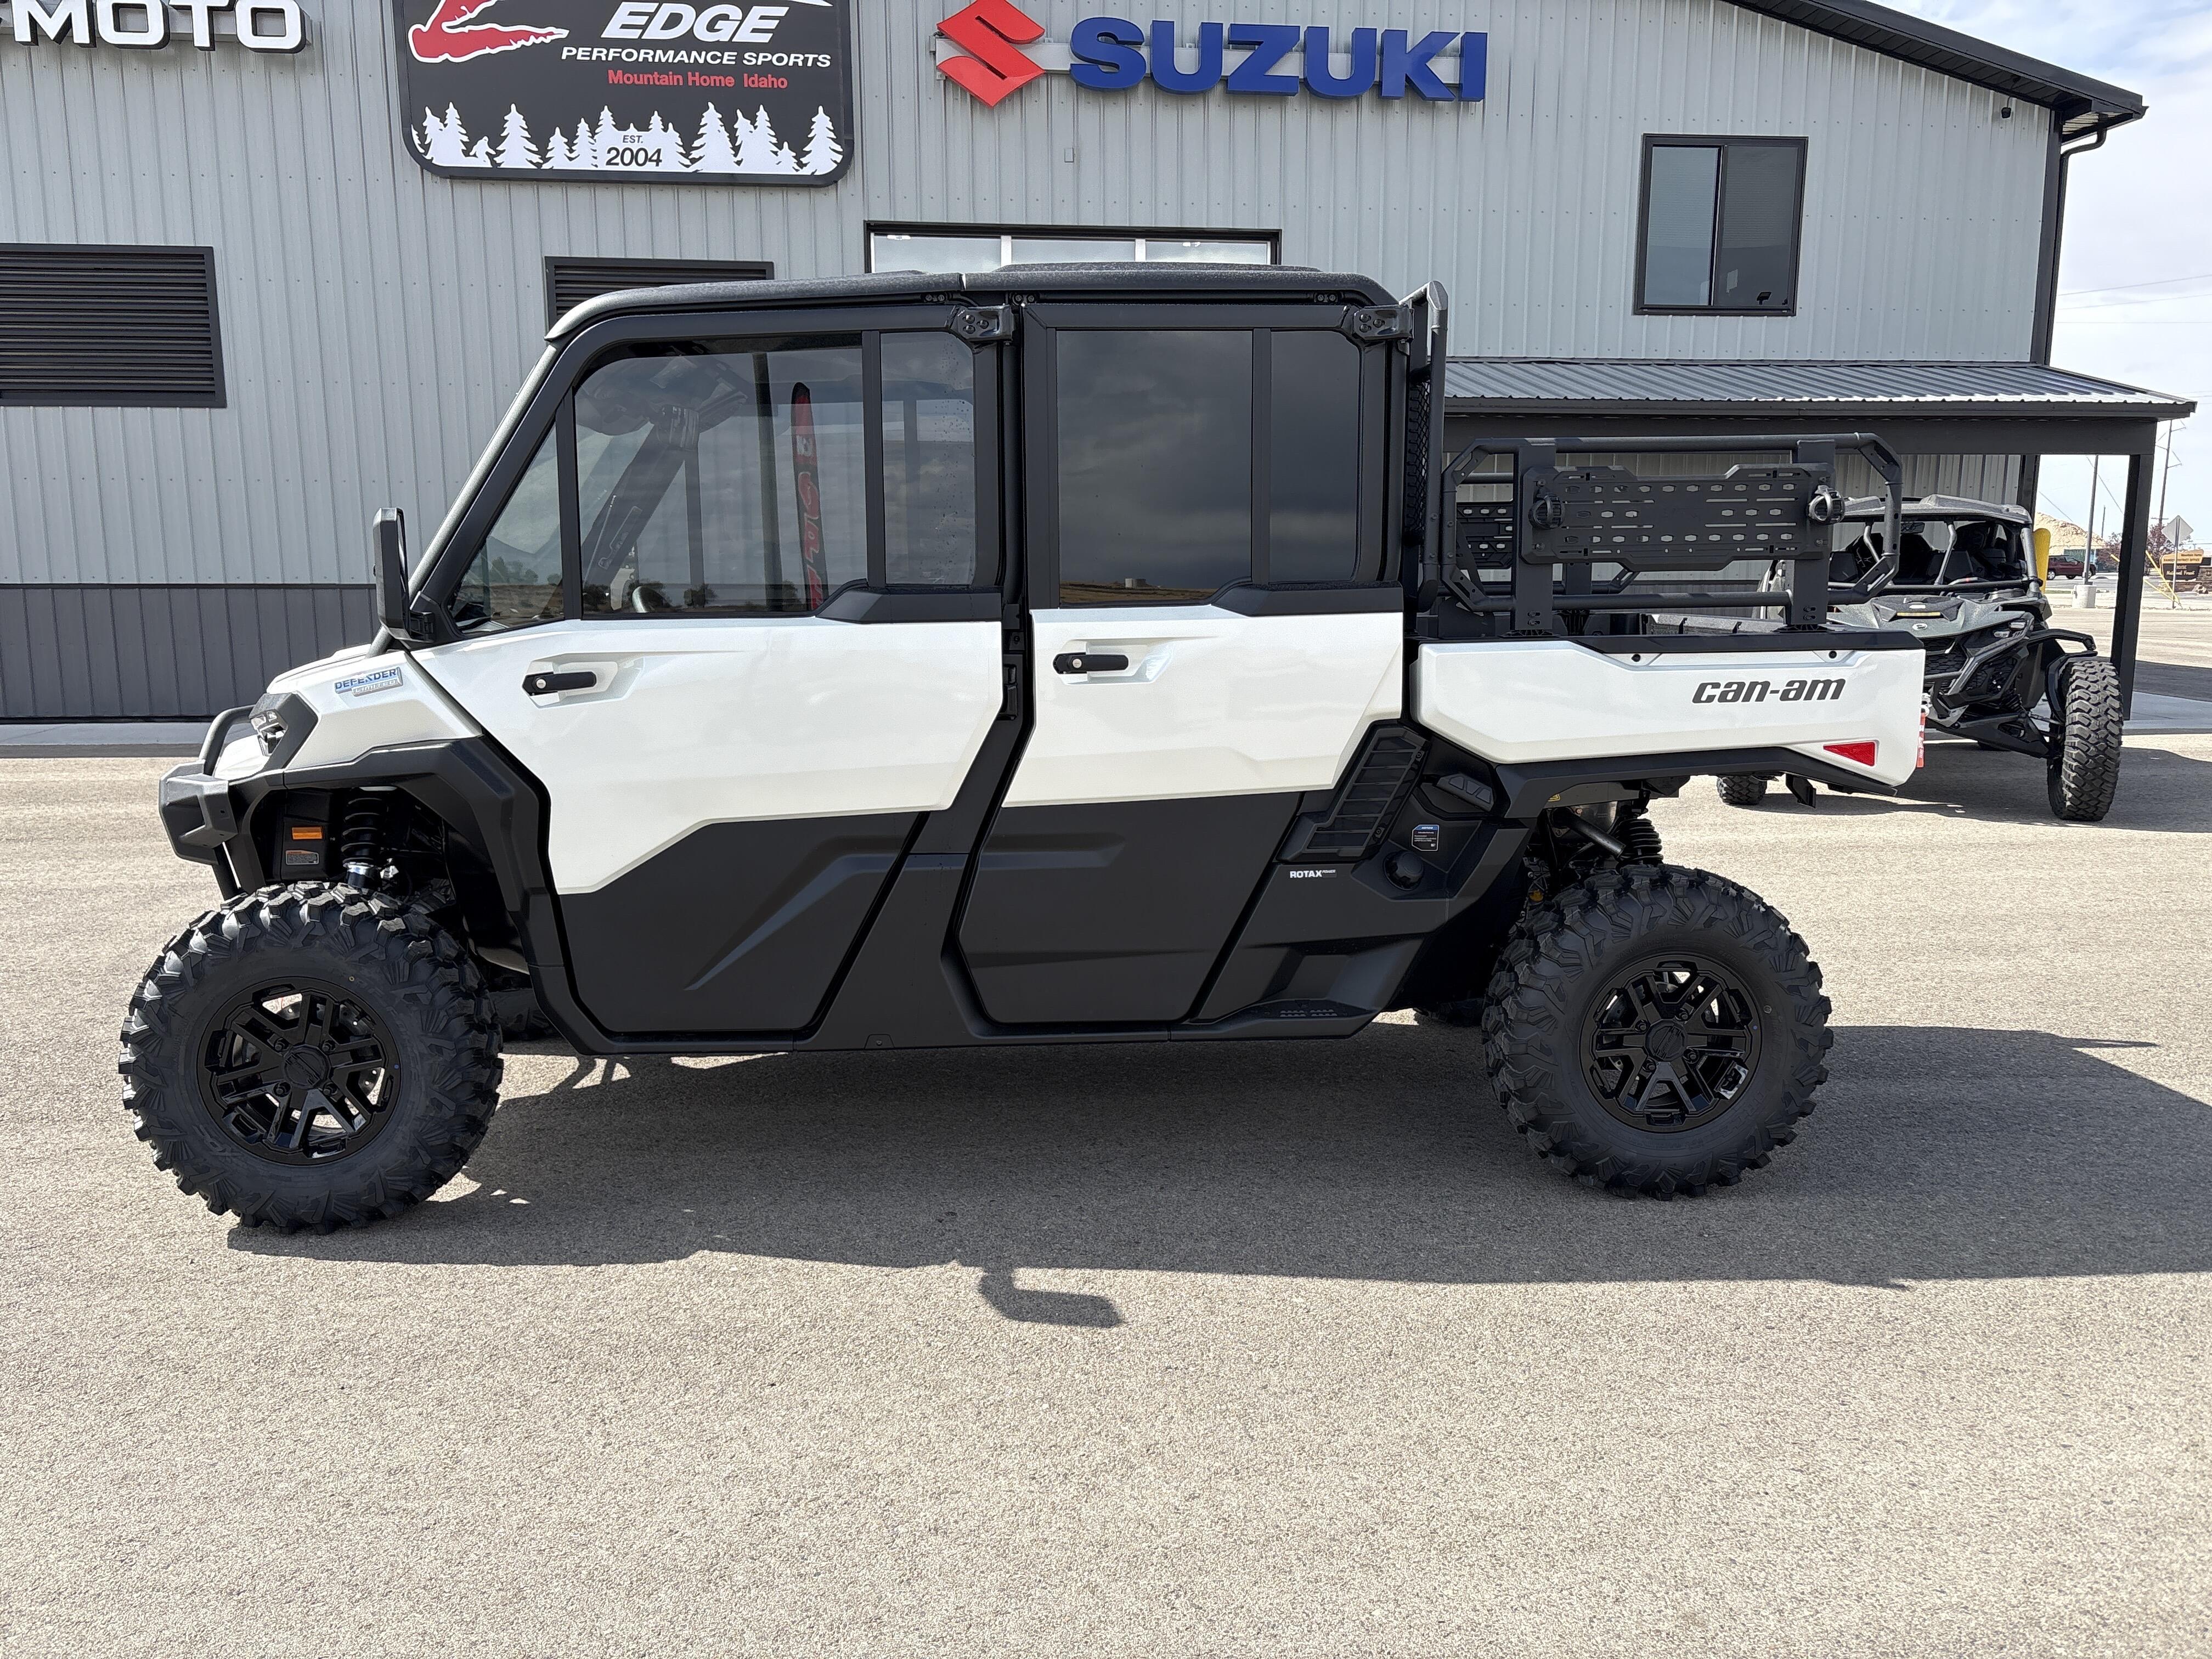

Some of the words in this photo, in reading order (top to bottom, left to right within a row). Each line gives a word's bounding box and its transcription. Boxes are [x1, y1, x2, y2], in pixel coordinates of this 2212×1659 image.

[600, 1, 790, 43] EDGE
[561, 46, 737, 65] PERFORMANCE
[742, 52, 832, 67] SPORTS
[1070, 16, 1487, 102] SUZUKI
[607, 70, 684, 86] Mountain
[687, 72, 735, 88] Home
[743, 74, 788, 89] Idaho
[622, 134, 644, 144] EST.
[605, 146, 663, 167] 2004
[335, 668, 397, 690] DEFENDER
[1692, 678, 1846, 704] can-am
[1289, 870, 1323, 878] ROTAX
